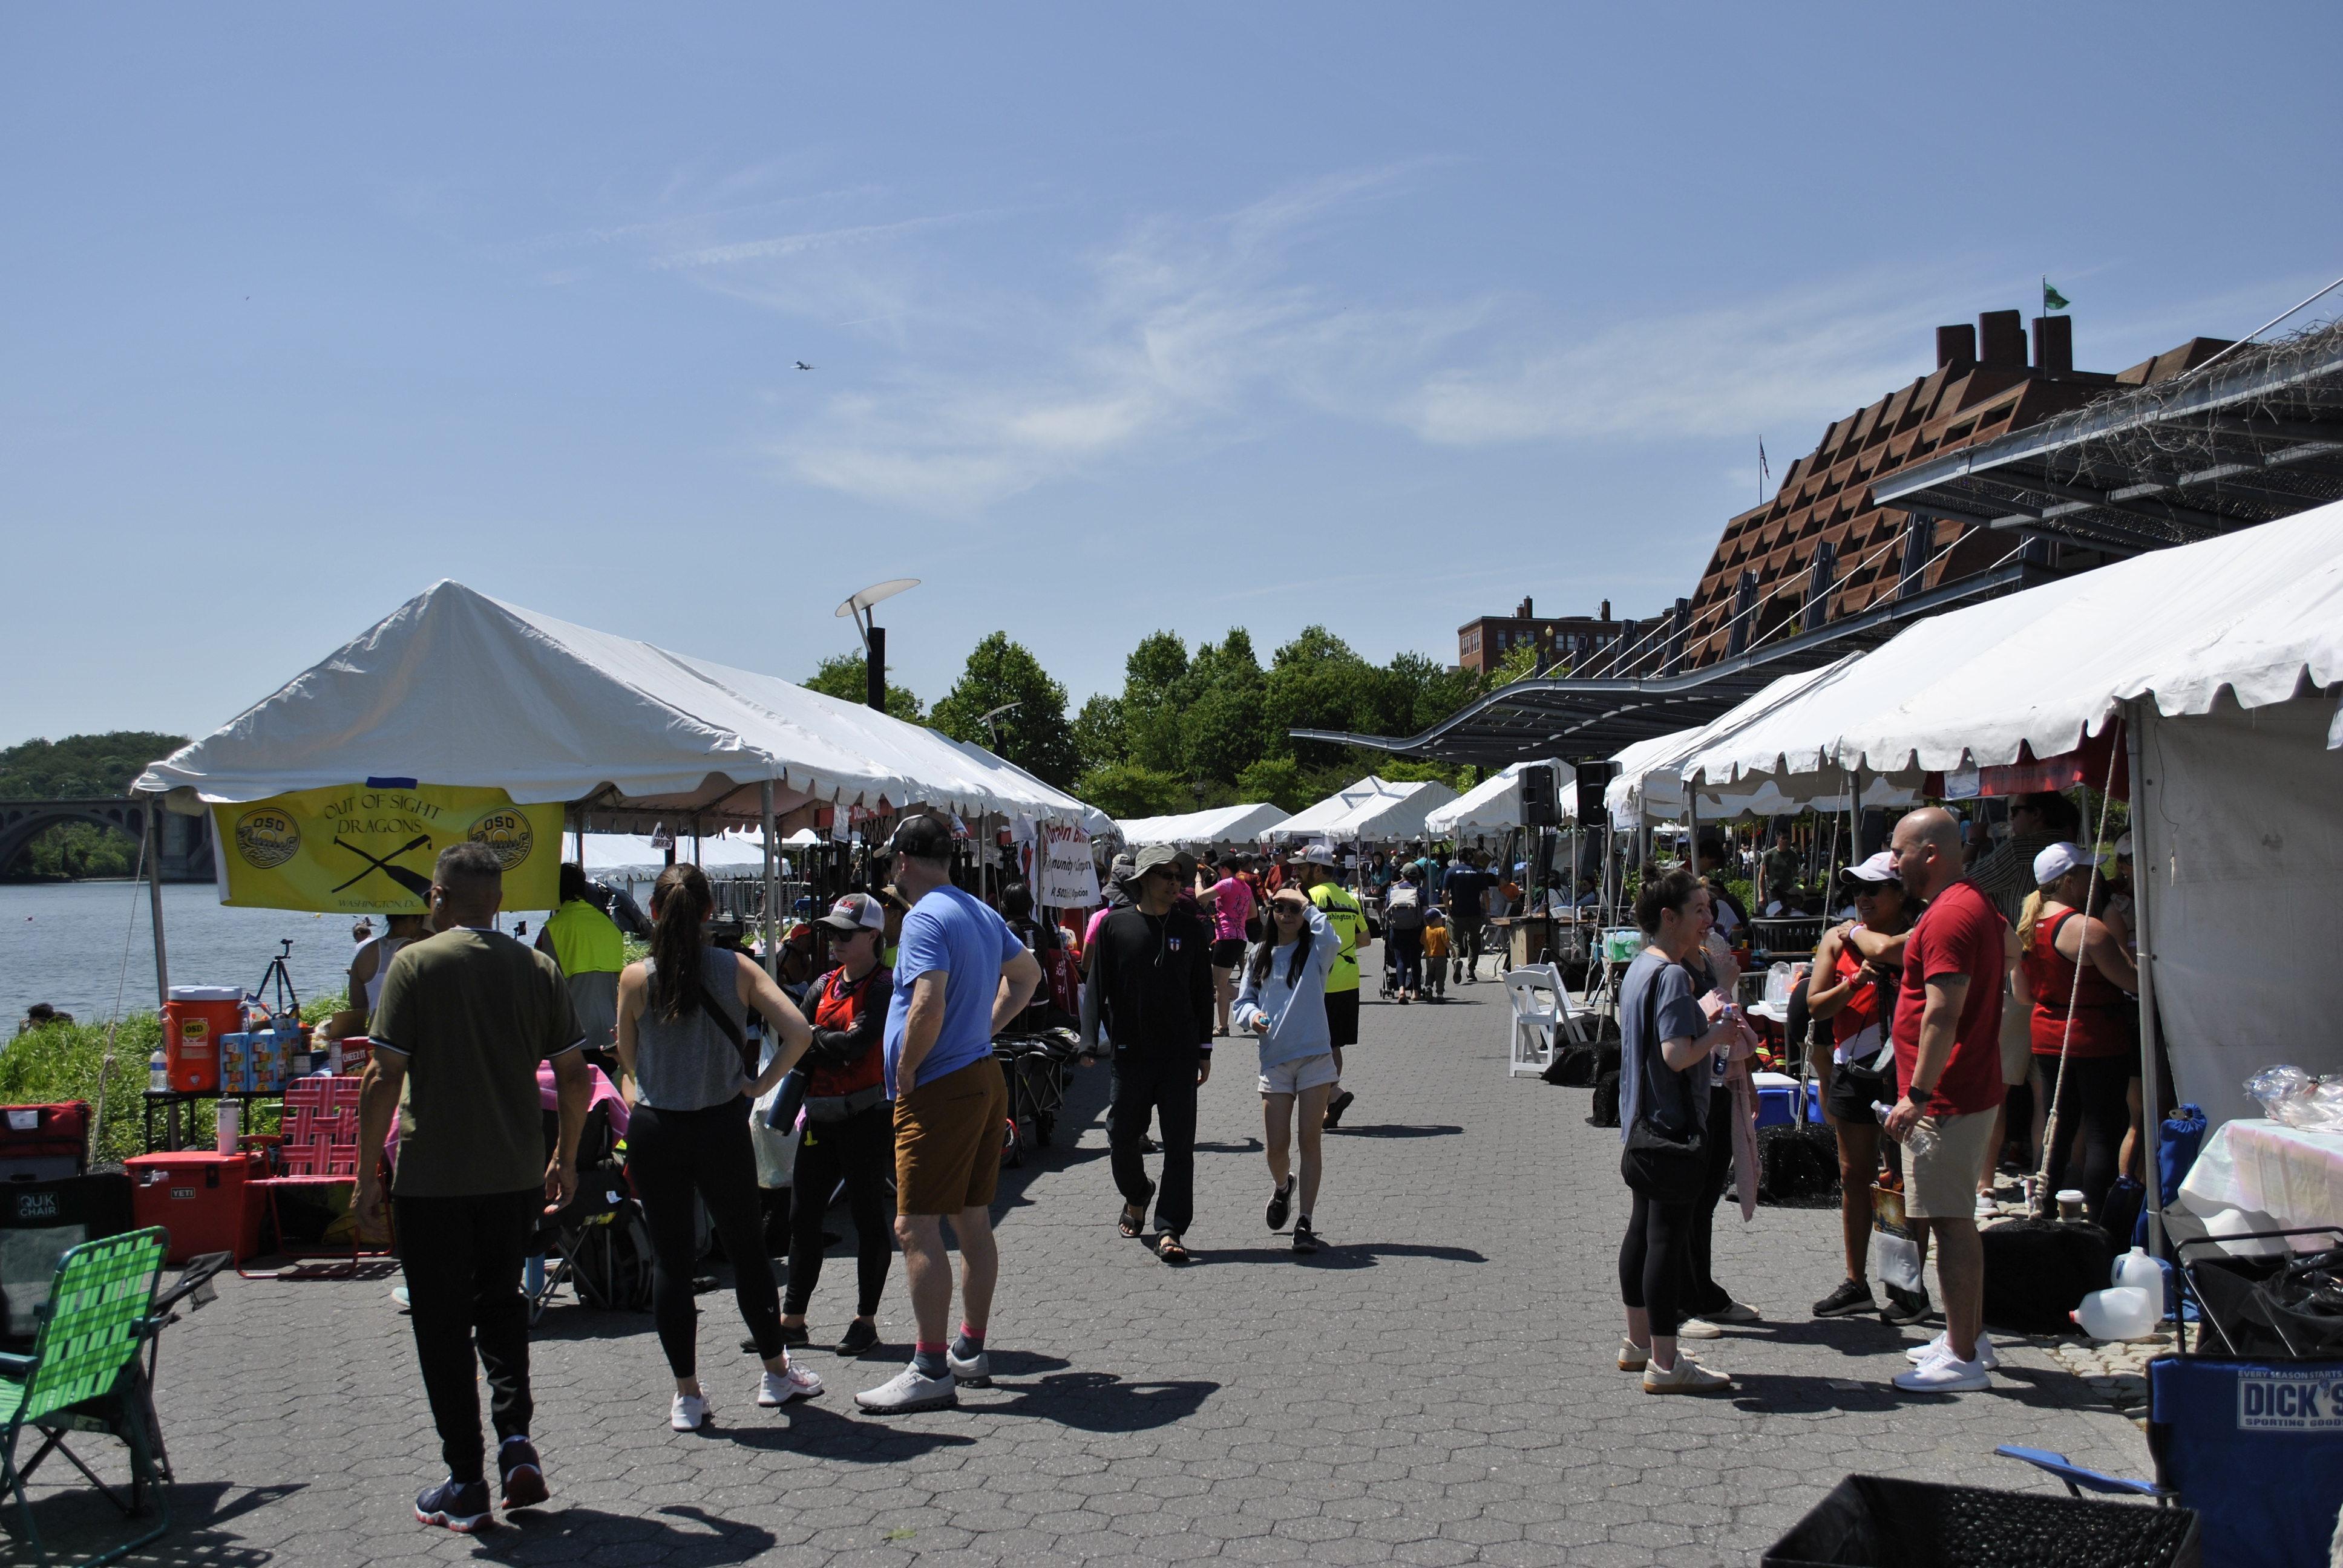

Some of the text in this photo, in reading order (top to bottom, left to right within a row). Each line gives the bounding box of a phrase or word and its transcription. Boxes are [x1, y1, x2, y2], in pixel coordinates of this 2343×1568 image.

[325, 794, 444, 820] OUT OF SIGHT
[254, 817, 285, 832] OSD
[338, 818, 422, 834] DRAGONS
[485, 816, 514, 831] OSD
[655, 827, 666, 838] NO
[339, 900, 419, 909] WASHINGTON, DC
[20, 1206, 56, 1217] CHAIR
[2270, 1371, 2308, 1379] SEASON
[2309, 1370, 2342, 1379] STARTS
[2244, 1382, 2343, 1417] DICK'S
[2246, 1418, 2304, 1427] SPORTING
